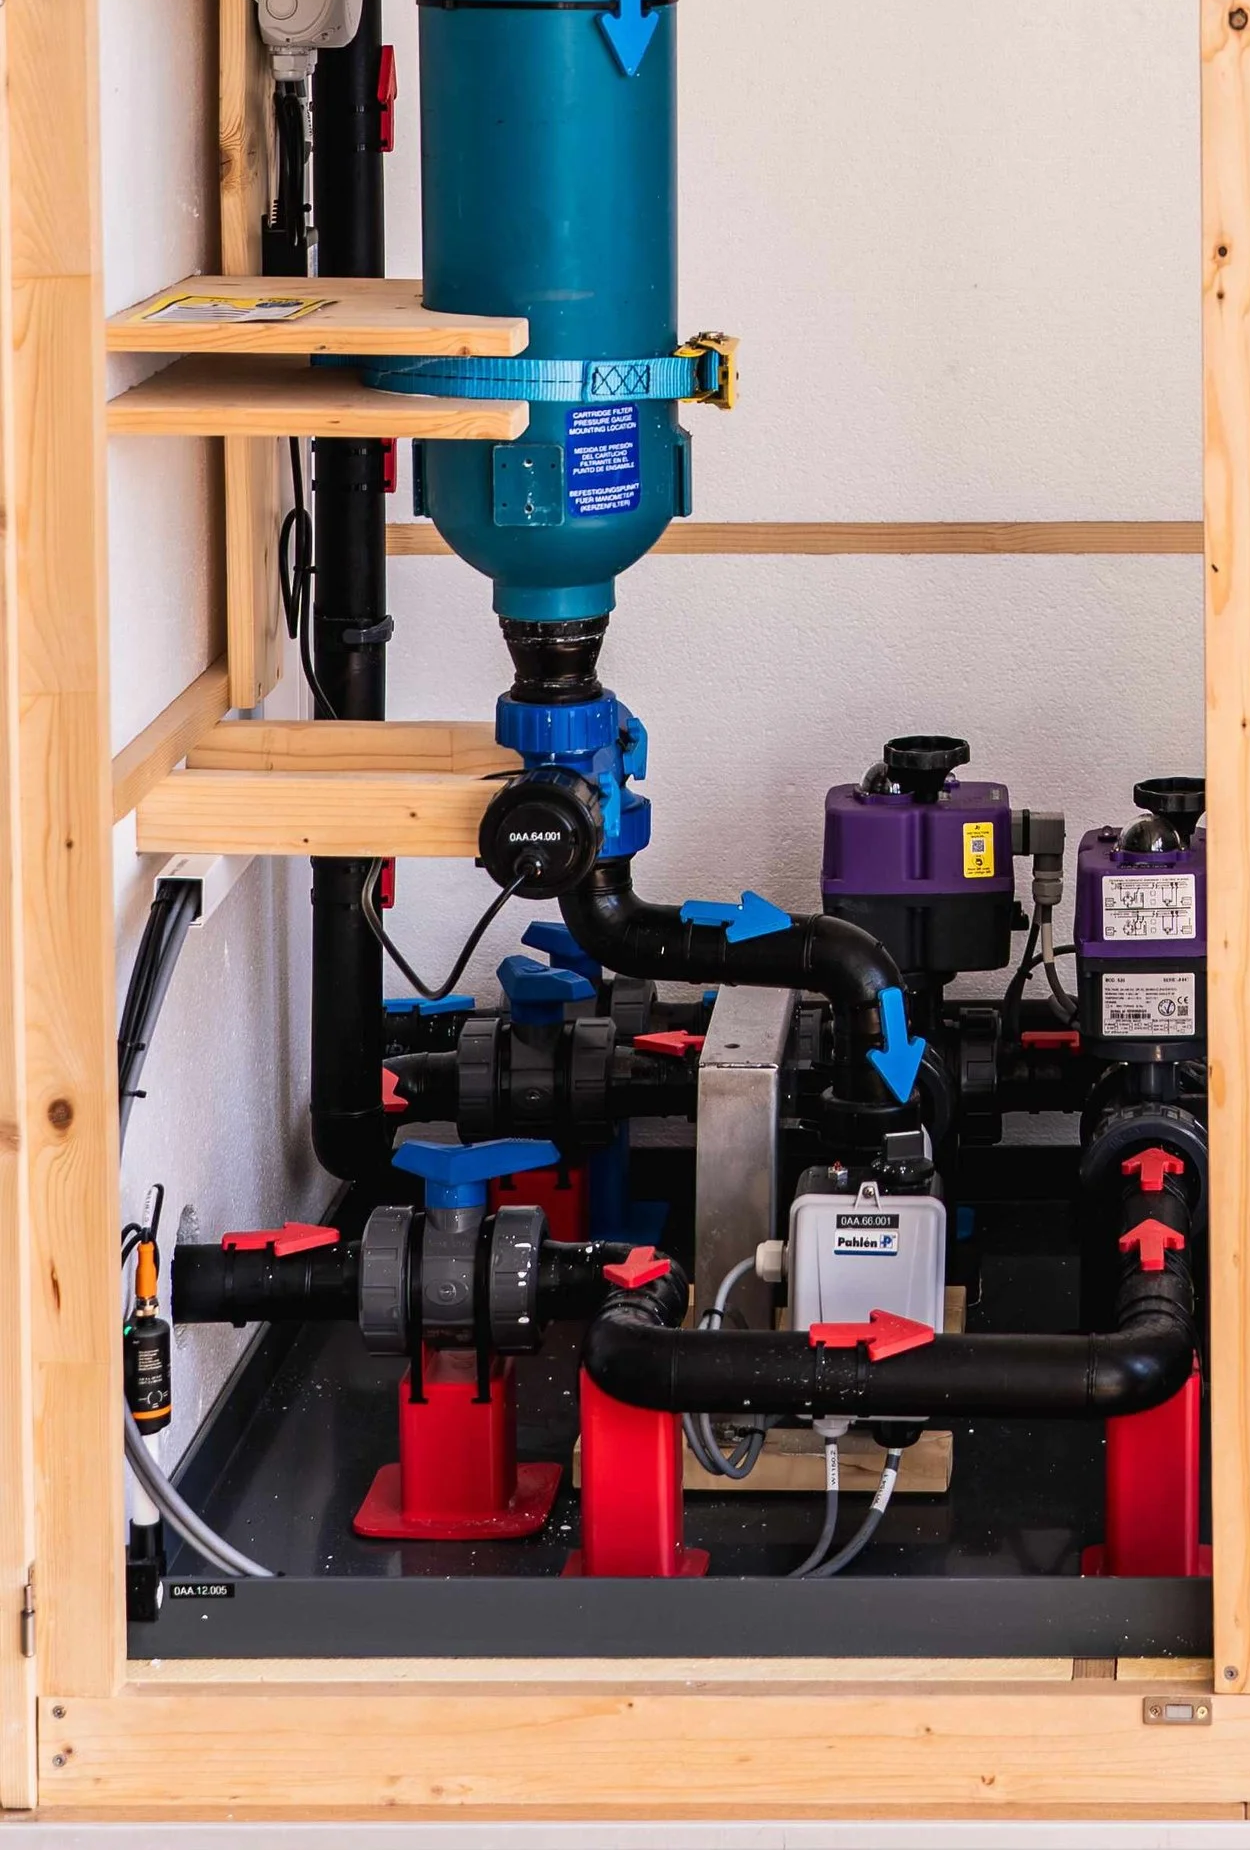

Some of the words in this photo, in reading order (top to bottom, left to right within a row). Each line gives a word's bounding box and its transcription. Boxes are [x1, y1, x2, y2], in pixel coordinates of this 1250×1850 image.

[573, 410, 611, 419] CARTRIDGE
[574, 418, 610, 427] PRESSURE
[611, 414, 632, 423] GAUGE
[569, 425, 605, 435] MOUNTING
[607, 422, 636, 431] LOCATION
[574, 446, 598, 454] MEDIDA
[595, 450, 627, 459] CARTUCHO
[573, 467, 595, 475] PUNTO
[575, 496, 594, 504] FUER
[595, 492, 634, 502] MANOMETER
[509, 831, 561, 842] 0AA.64.001
[841, 1217, 890, 1225] 0AA.66.001
[838, 1237, 877, 1247] Pahlén
[174, 1586, 227, 1595] 0AA.12.005
